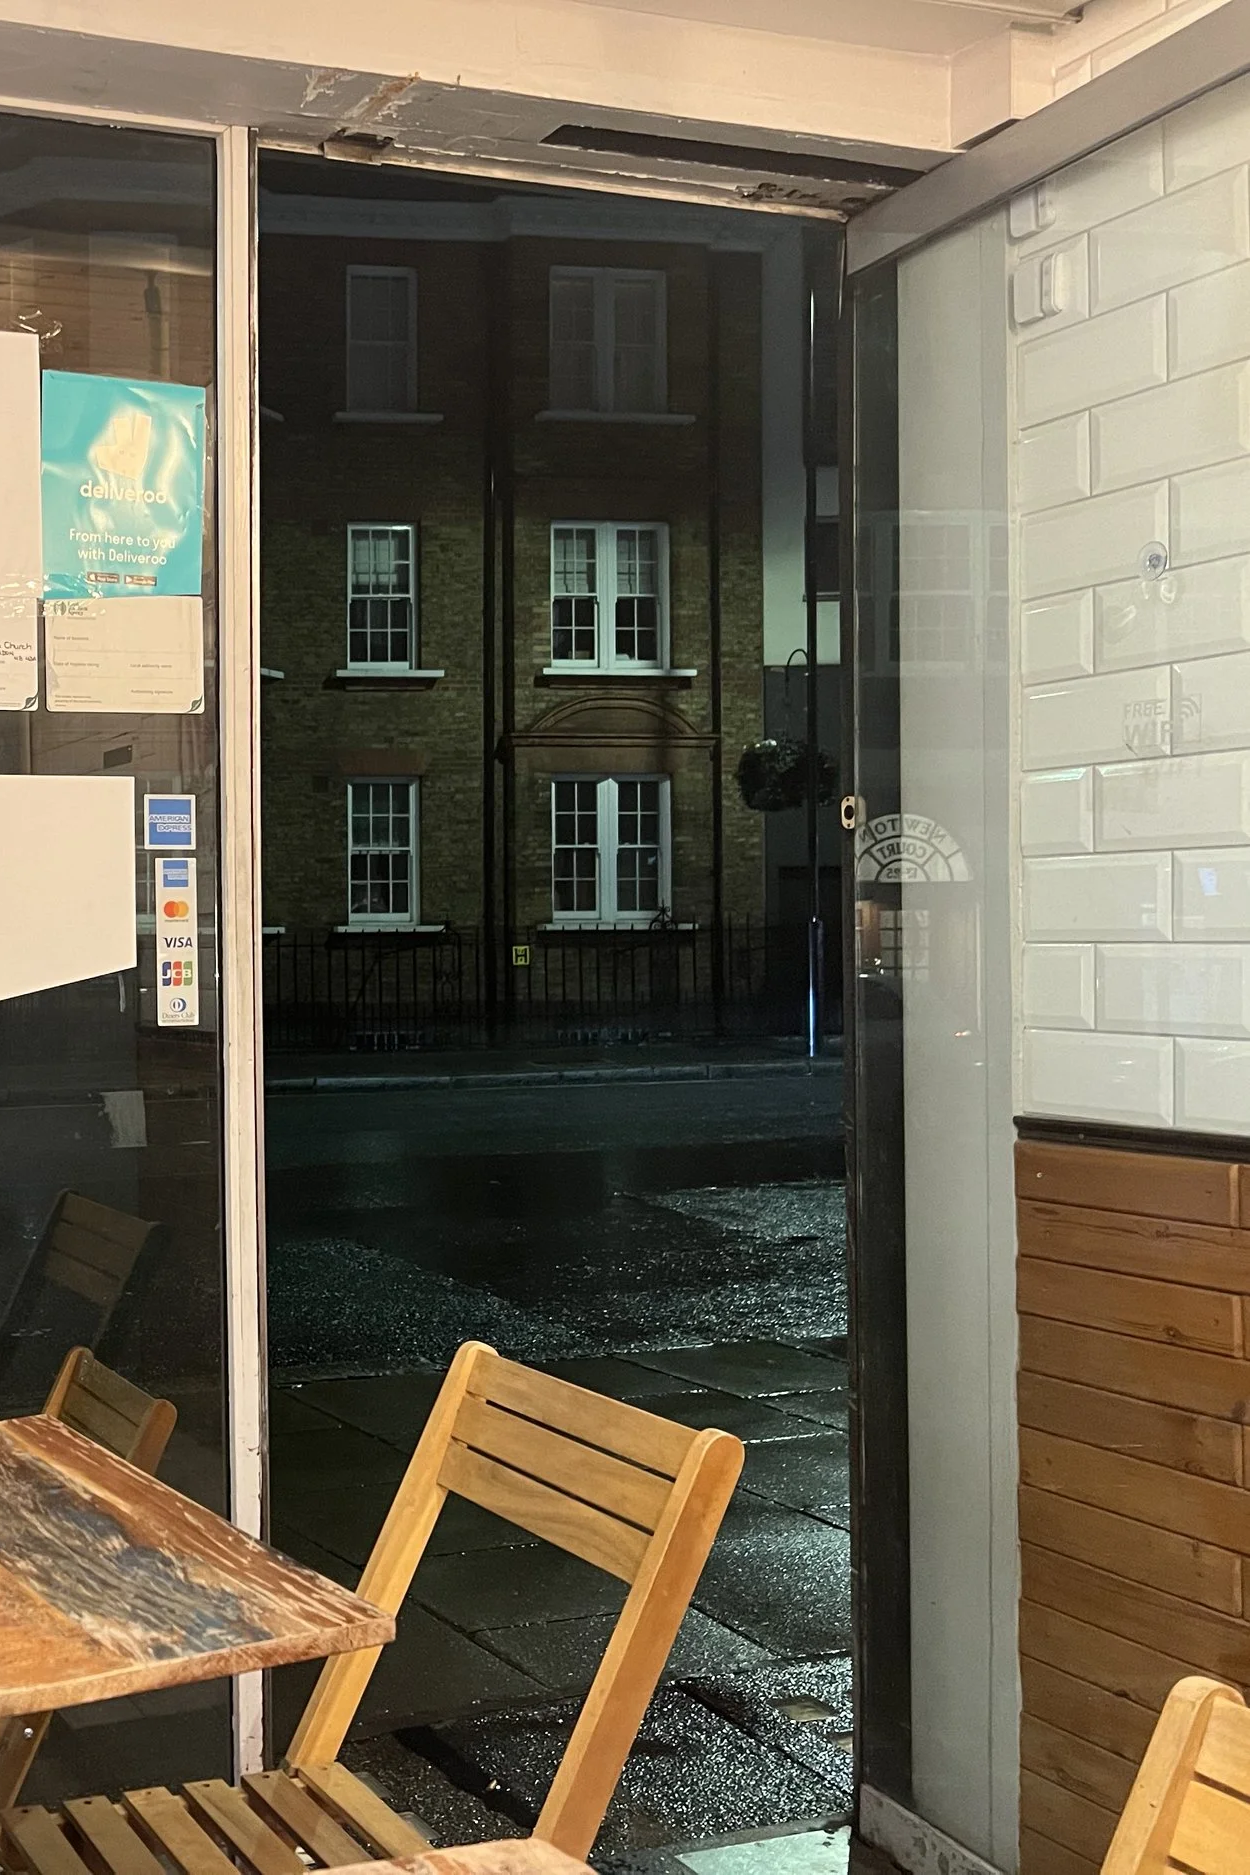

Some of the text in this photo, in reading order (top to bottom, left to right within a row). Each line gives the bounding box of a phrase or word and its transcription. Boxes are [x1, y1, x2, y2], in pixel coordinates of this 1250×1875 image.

[79, 479, 168, 504] deliveroo
[69, 528, 176, 552] From here to you
[77, 547, 168, 566] with Deliveroo
[3, 641, 33, 651] Church
[1123, 700, 1166, 719] FREE
[149, 815, 189, 823] AMERICAN
[158, 824, 192, 832] EXPRESS
[163, 937, 193, 948] VISA
